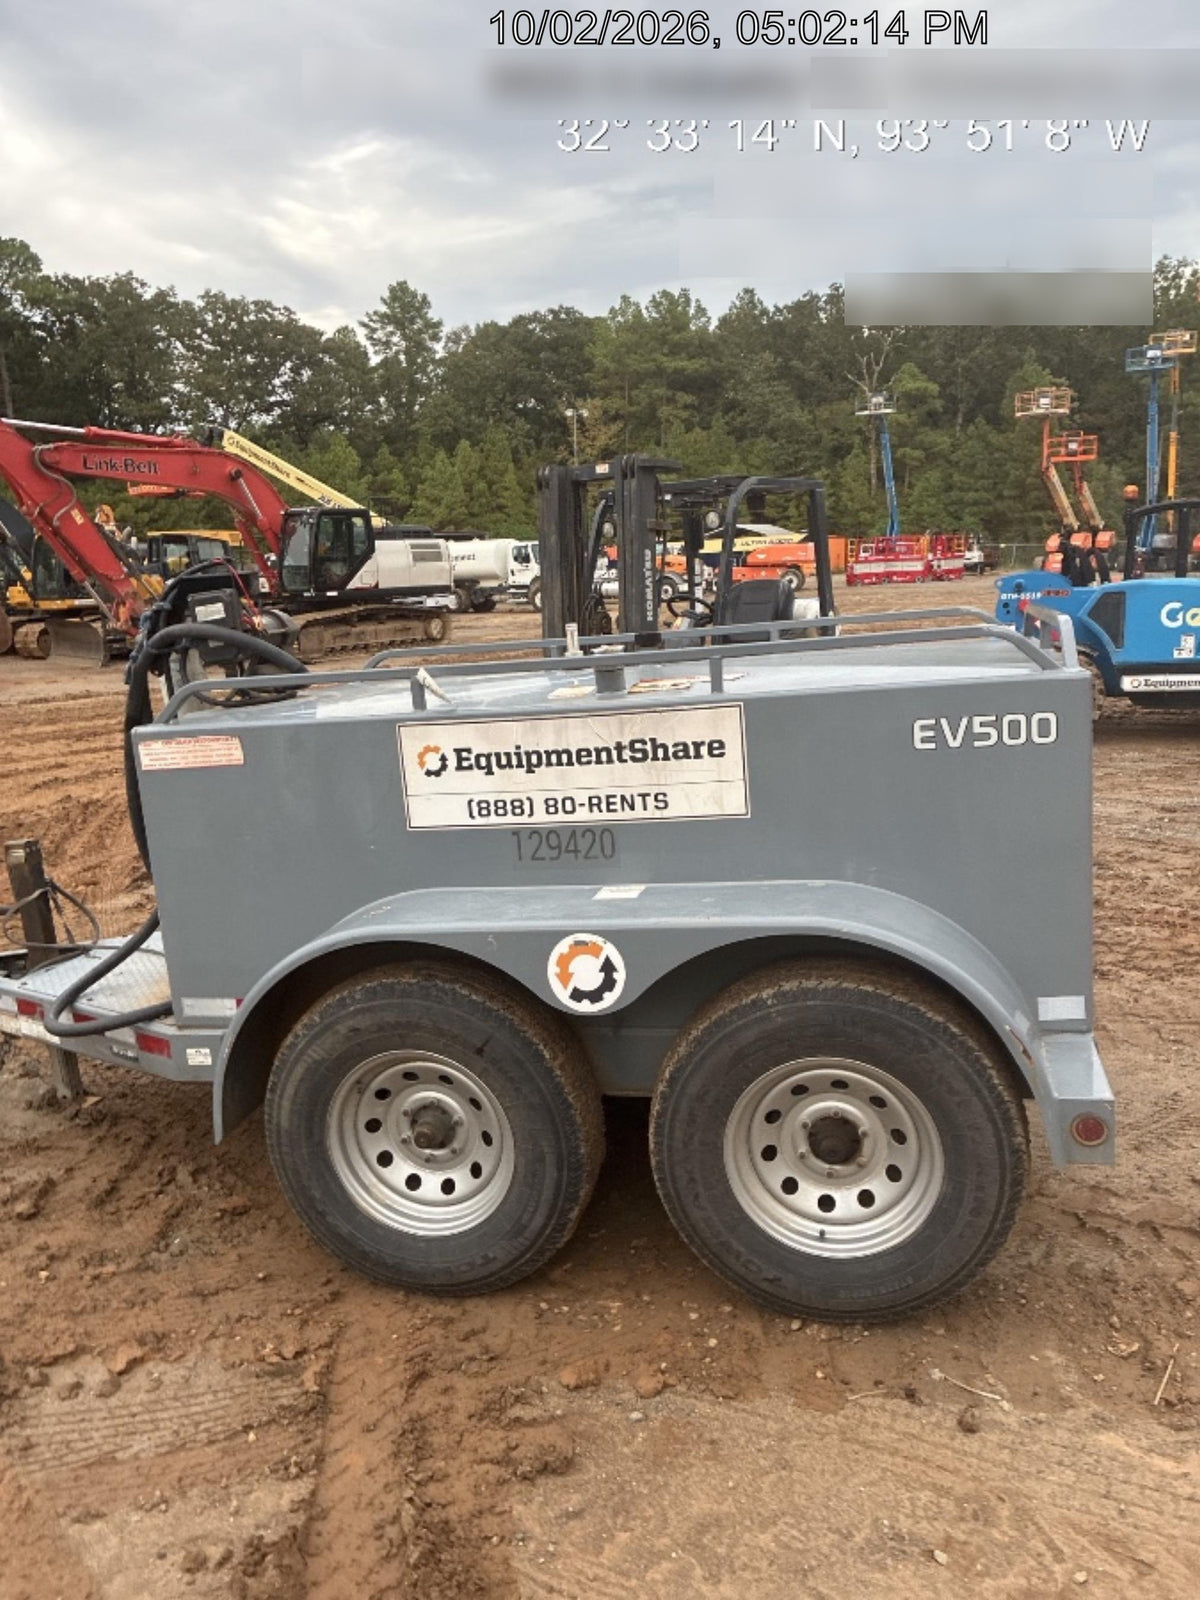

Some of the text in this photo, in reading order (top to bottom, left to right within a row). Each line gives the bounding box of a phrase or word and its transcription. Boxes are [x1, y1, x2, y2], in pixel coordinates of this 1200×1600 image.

[82, 453, 158, 475] Link-Belt
[643, 548, 654, 622] KOMATSU
[912, 711, 1058, 751] EV500
[453, 737, 727, 776] EquipmentShare
[467, 792, 670, 820] (888) 80-RENTS
[510, 827, 616, 862] 129420
